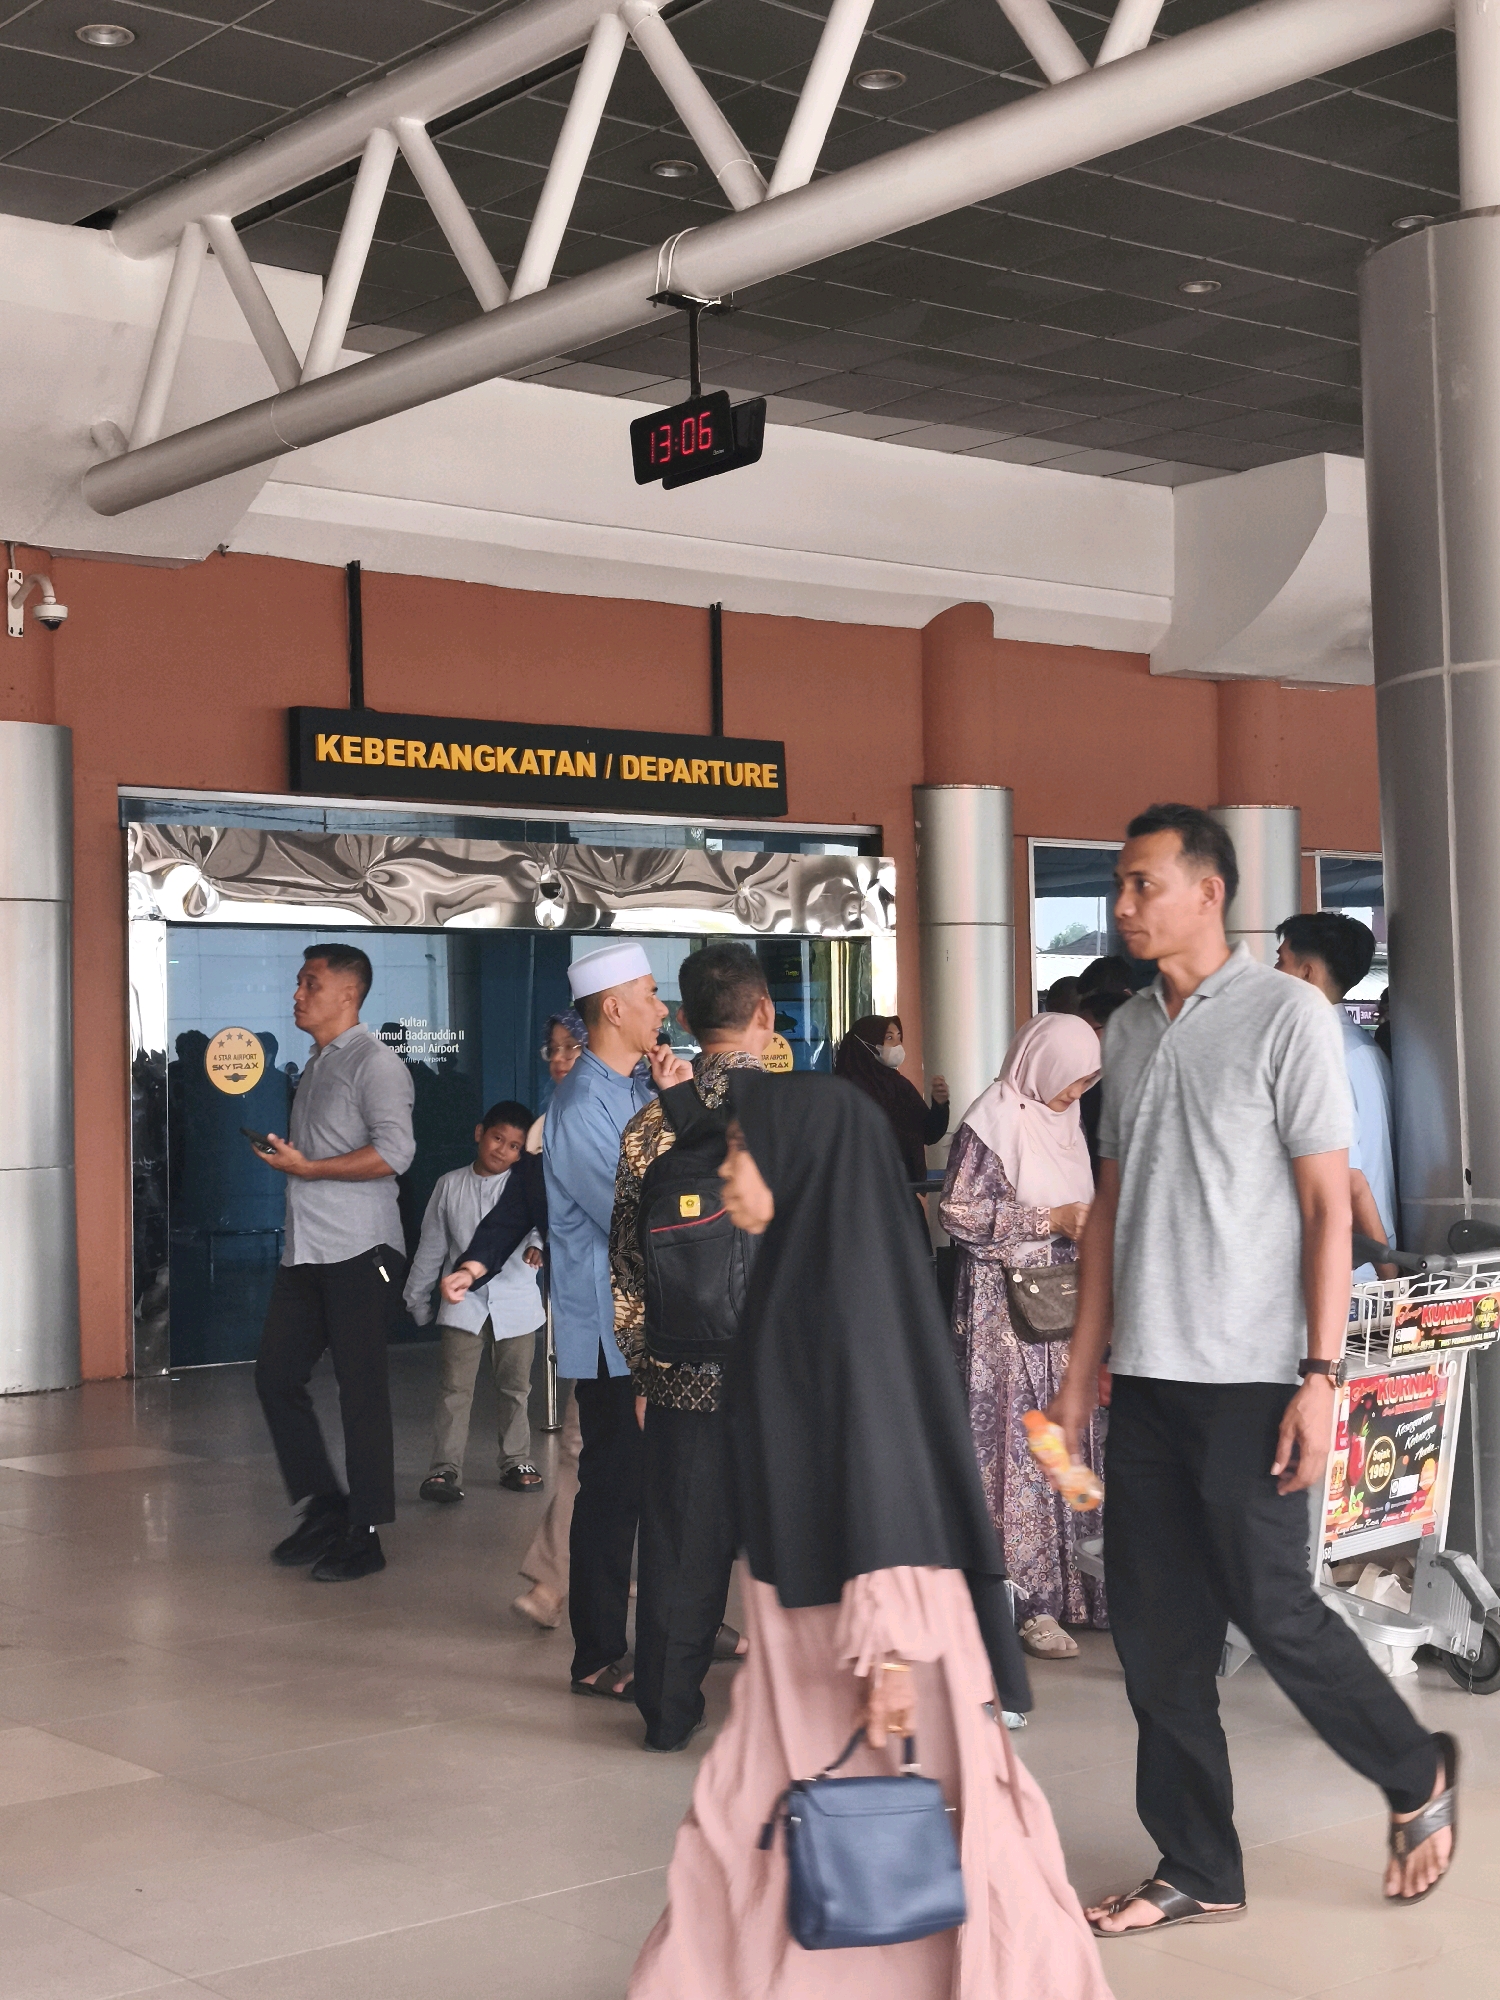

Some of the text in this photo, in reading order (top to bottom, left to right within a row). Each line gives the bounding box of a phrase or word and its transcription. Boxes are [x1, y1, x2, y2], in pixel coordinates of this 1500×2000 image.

[650, 411, 712, 463] 13:06
[315, 733, 597, 778] KEBERANGKATAN
[620, 754, 779, 788] DEPARTURE
[400, 1016, 427, 1027] Sultan
[405, 1029, 457, 1041] Badaruddin
[389, 1042, 460, 1054] national Airport
[233, 1053, 257, 1061] AIRPORT
[211, 1061, 259, 1072] SKYTRAX
[1421, 1299, 1474, 1328] KURNIA
[1377, 1372, 1435, 1406] KURNIA
[1368, 1462, 1391, 1480] 1969
